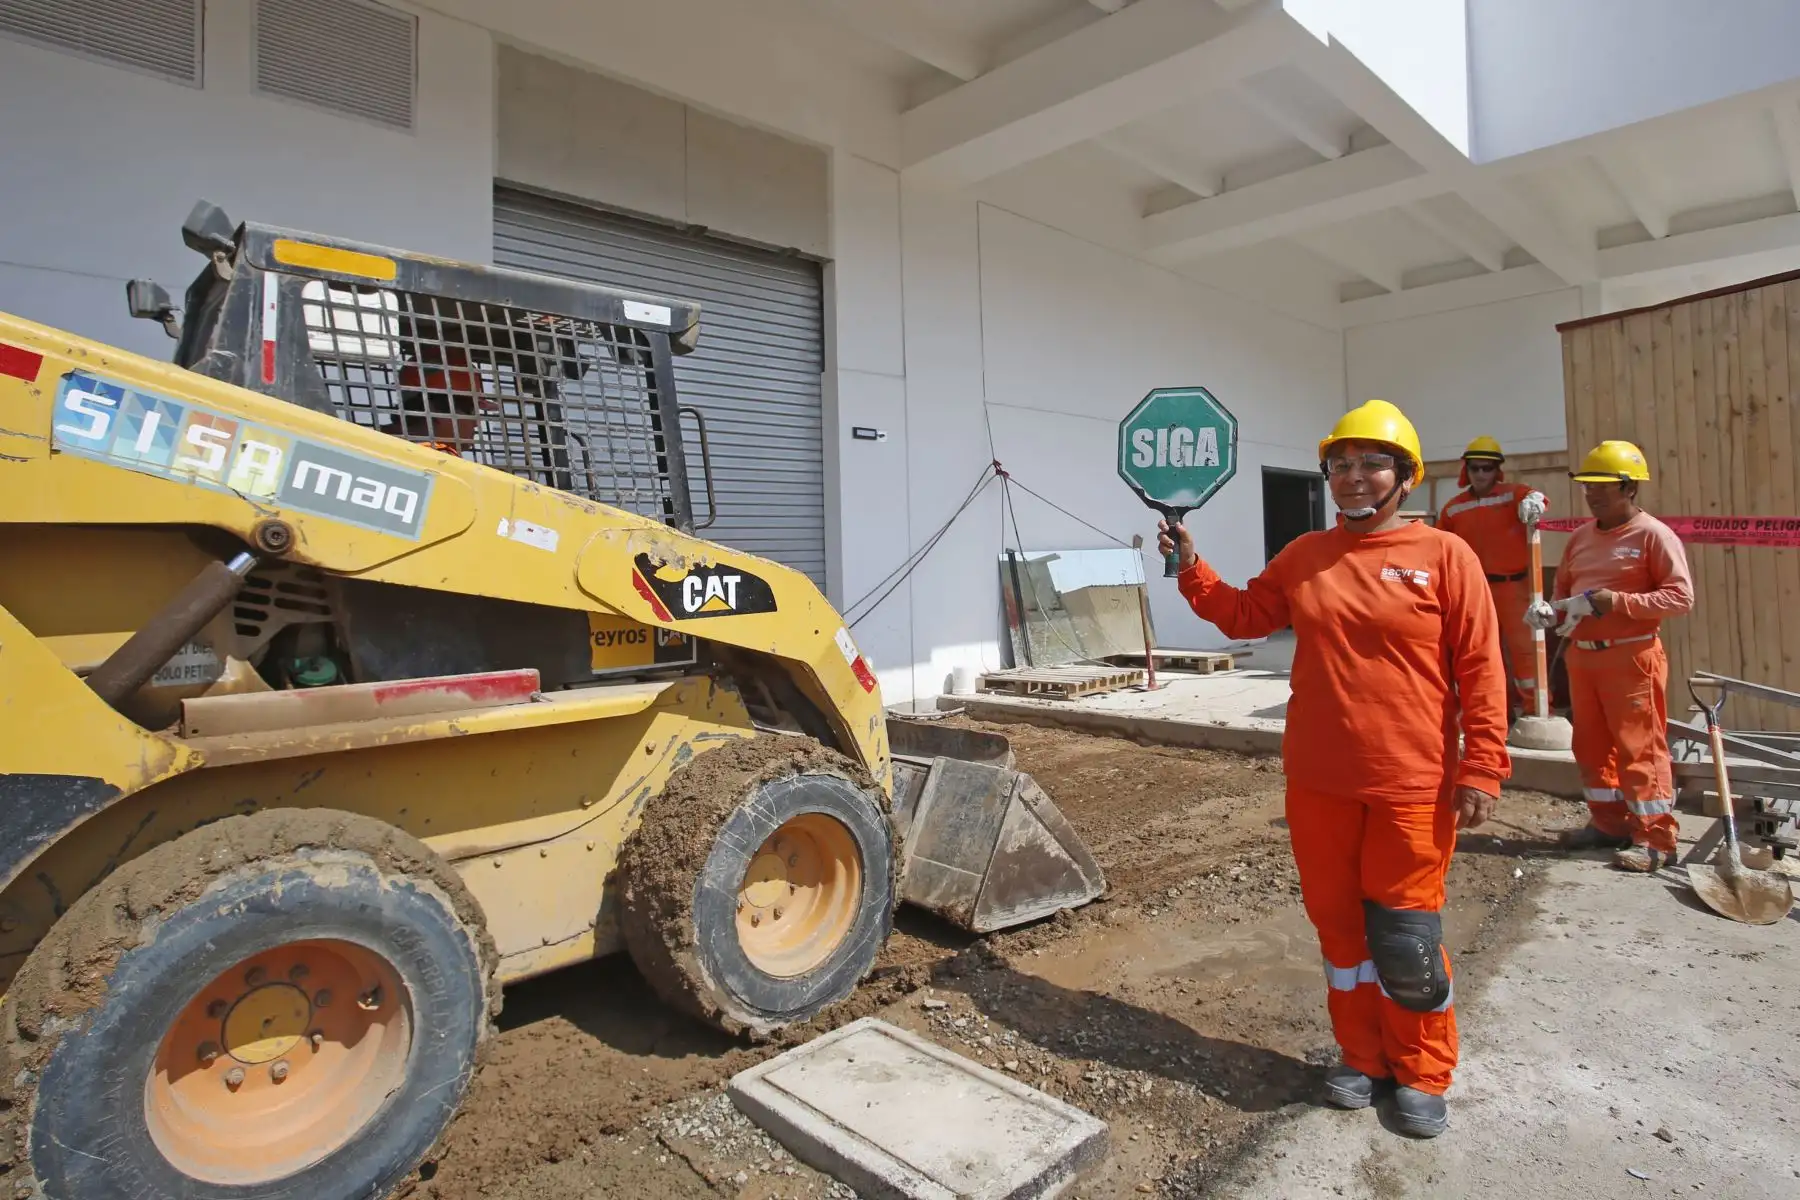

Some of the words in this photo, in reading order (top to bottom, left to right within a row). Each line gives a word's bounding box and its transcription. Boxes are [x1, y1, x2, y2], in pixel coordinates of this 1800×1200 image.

[56, 388, 283, 483] SISA
[292, 460, 419, 524] maq
[1132, 427, 1220, 468] SIGA
[1693, 519, 1750, 532] CUIDADO
[1381, 567, 1415, 578] sacyr
[682, 574, 741, 613] CAT
